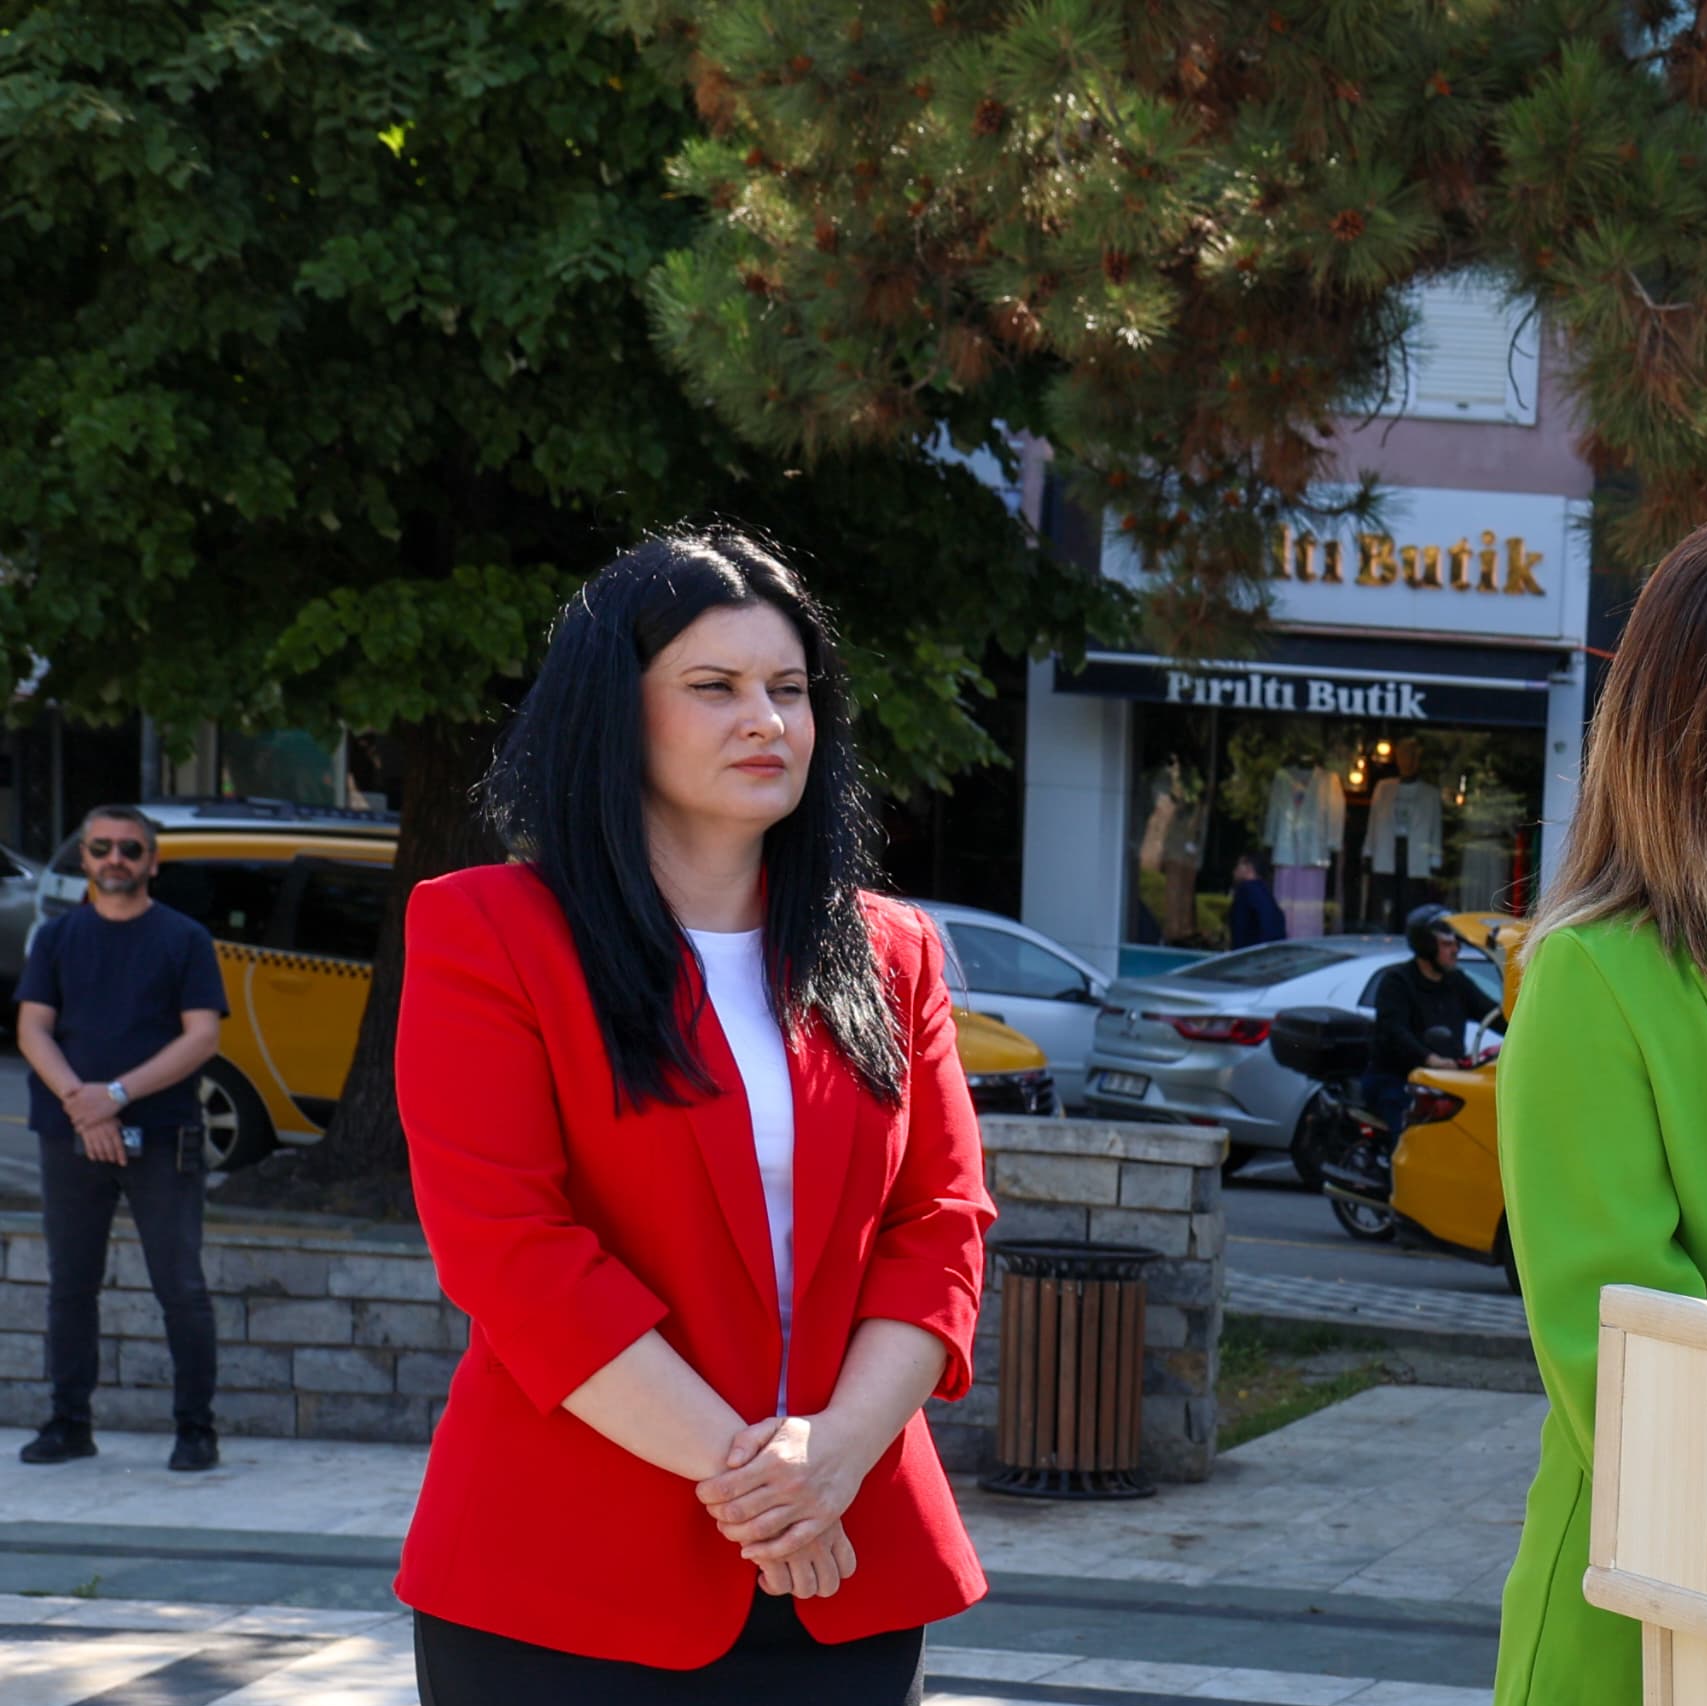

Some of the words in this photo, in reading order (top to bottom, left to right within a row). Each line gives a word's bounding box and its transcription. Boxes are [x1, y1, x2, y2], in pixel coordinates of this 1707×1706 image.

[1355, 530, 1546, 597] Butik
[1166, 671, 1296, 711] Pırıltı
[1306, 680, 1428, 720] Butik
